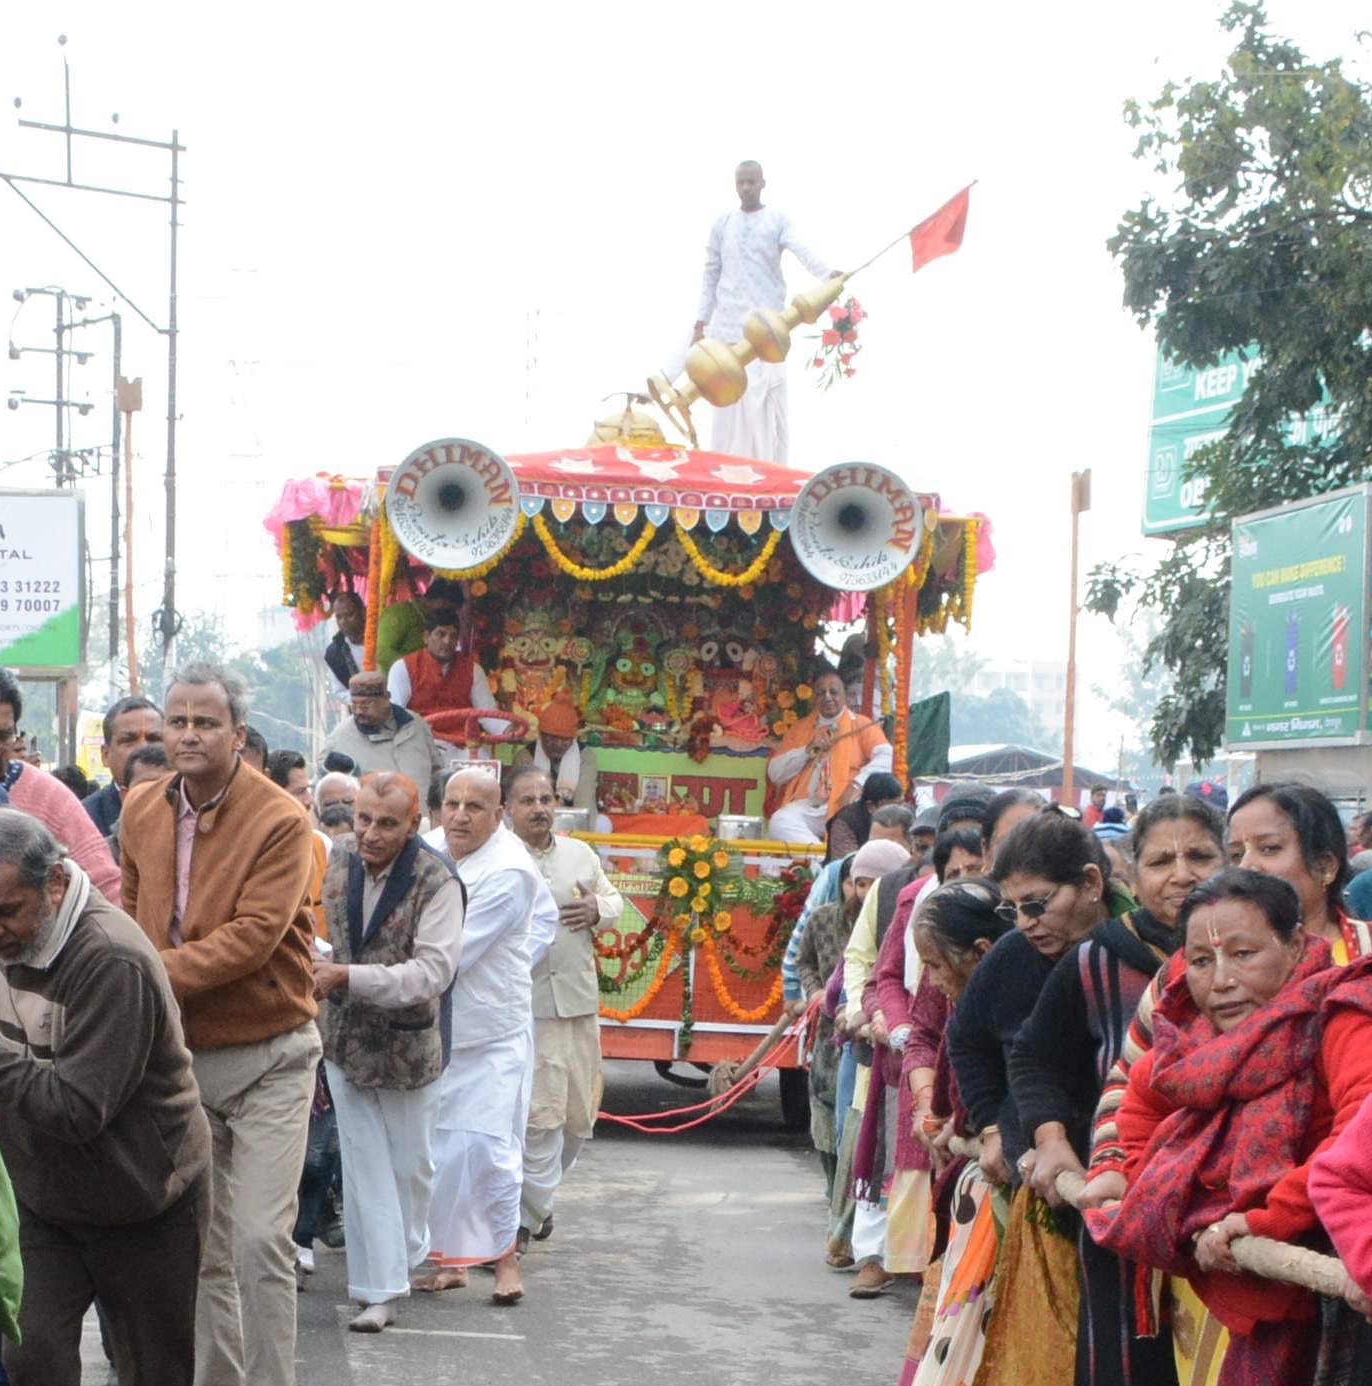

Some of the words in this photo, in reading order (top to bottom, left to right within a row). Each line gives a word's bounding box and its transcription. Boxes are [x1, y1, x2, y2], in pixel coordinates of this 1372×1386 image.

[1194, 364, 1237, 400] KEEP
[395, 444, 513, 505] DHIMAN
[807, 467, 916, 554] DHIMAN
[15, 580, 61, 593] 31222
[16, 599, 61, 612] 70007
